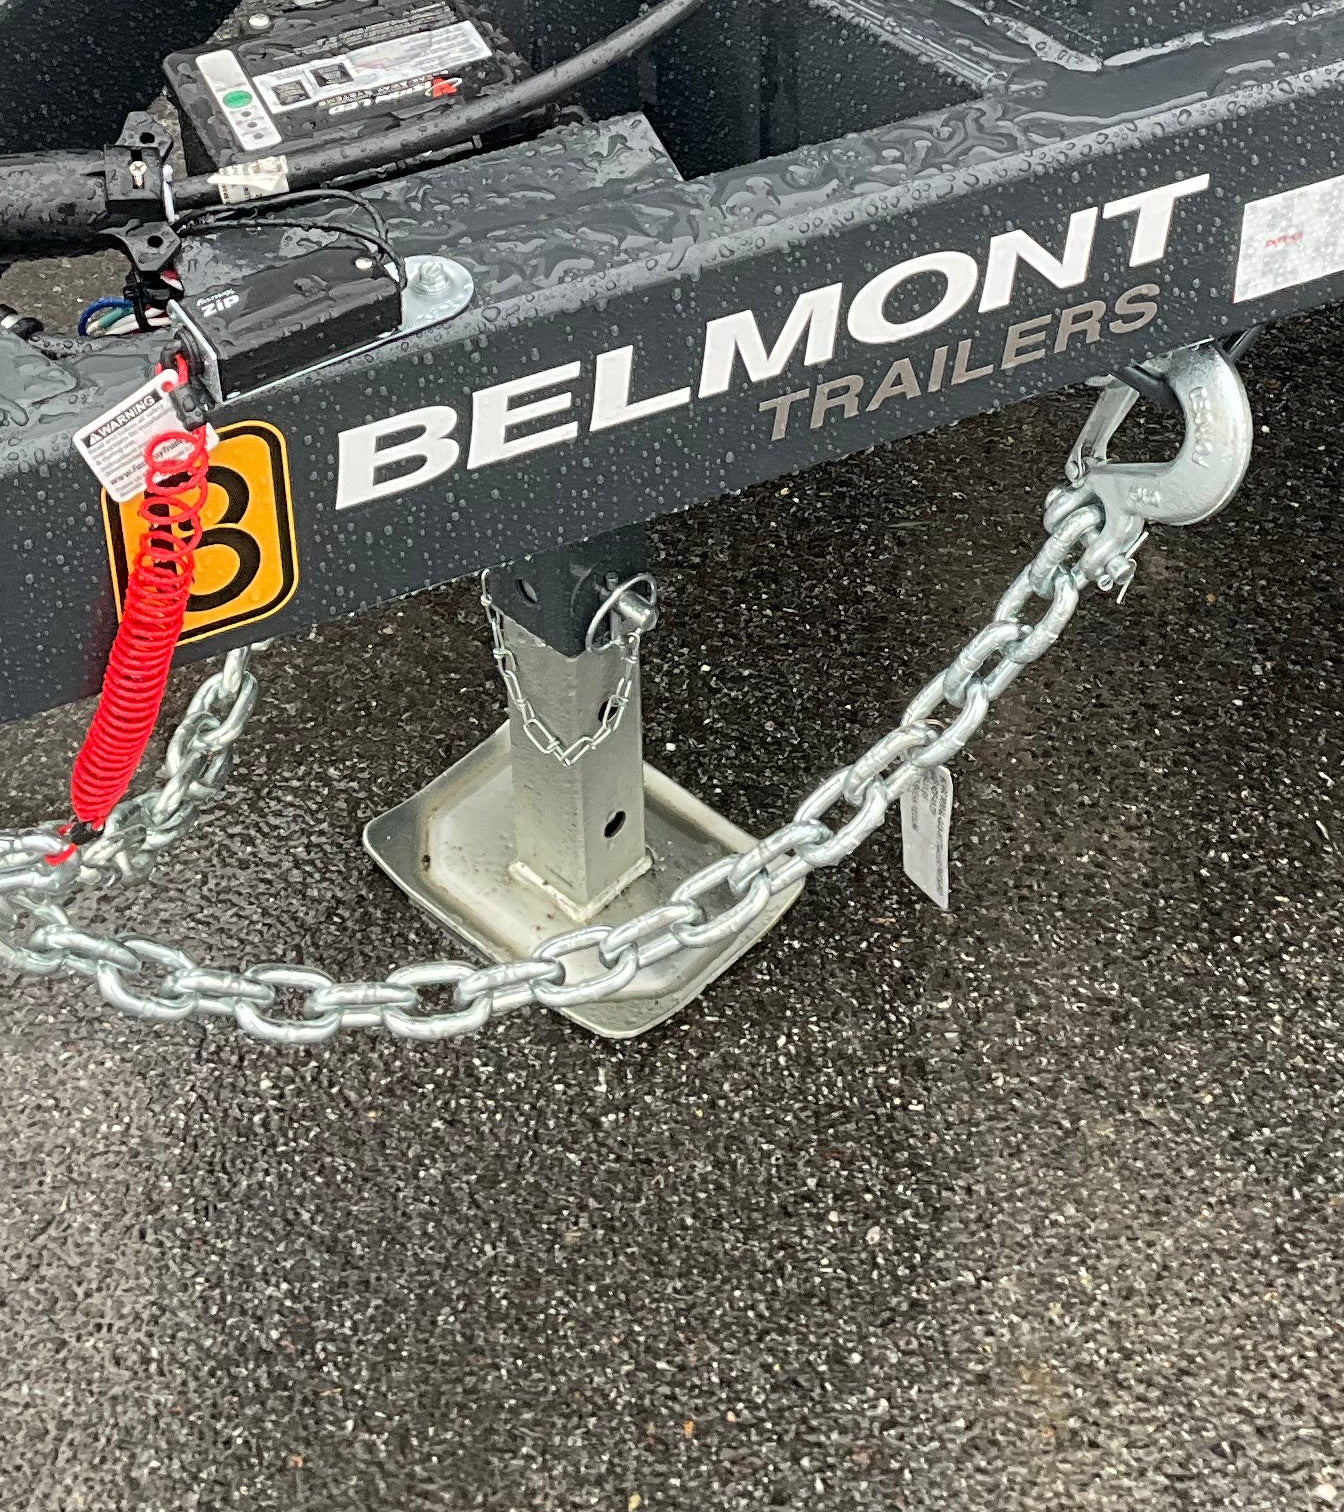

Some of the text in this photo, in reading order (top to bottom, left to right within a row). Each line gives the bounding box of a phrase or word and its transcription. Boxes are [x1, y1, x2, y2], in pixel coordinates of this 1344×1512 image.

[97, 394, 156, 437] WARNING
[335, 173, 1211, 510] BELMONT
[758, 283, 1161, 442] TRAILERS
